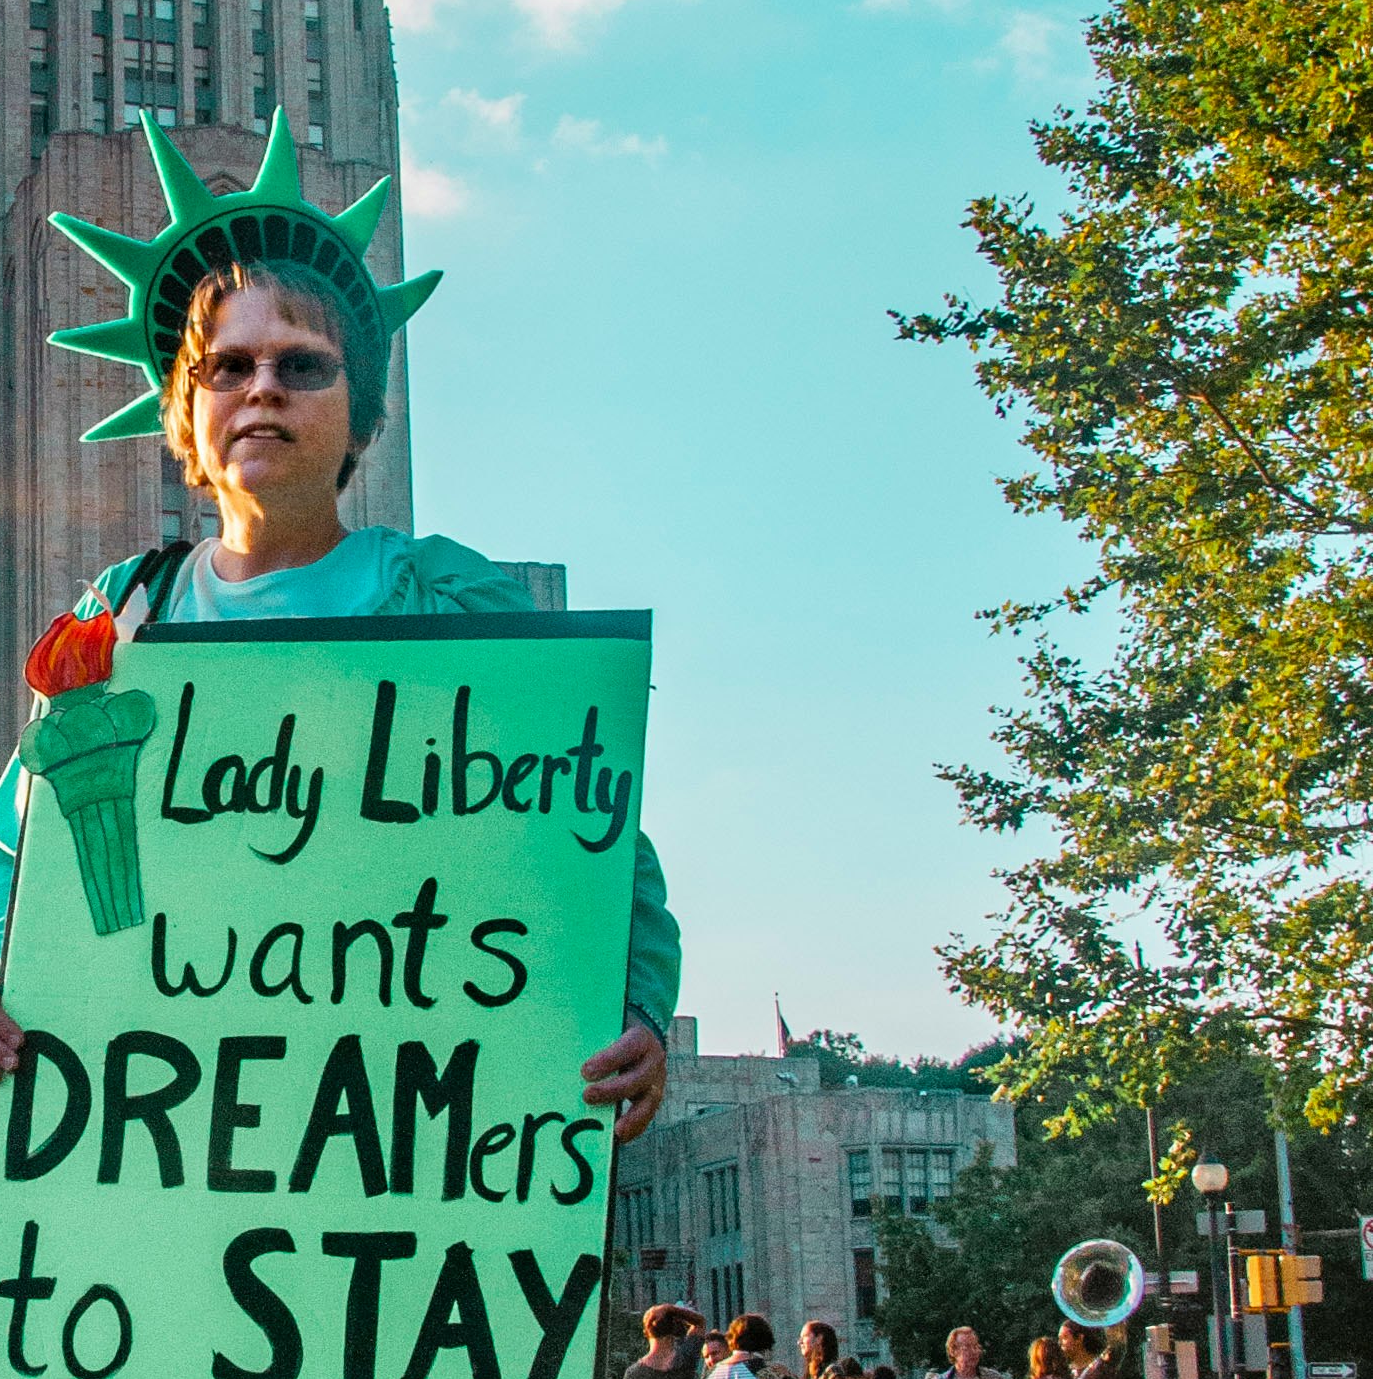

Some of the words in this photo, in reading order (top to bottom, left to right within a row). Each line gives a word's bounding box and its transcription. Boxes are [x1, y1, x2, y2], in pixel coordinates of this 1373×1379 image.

[161, 681, 323, 865] Lady
[360, 679, 633, 854] Liberty
[152, 877, 528, 1010] wants
[4, 1030, 605, 1206] DREAMers
